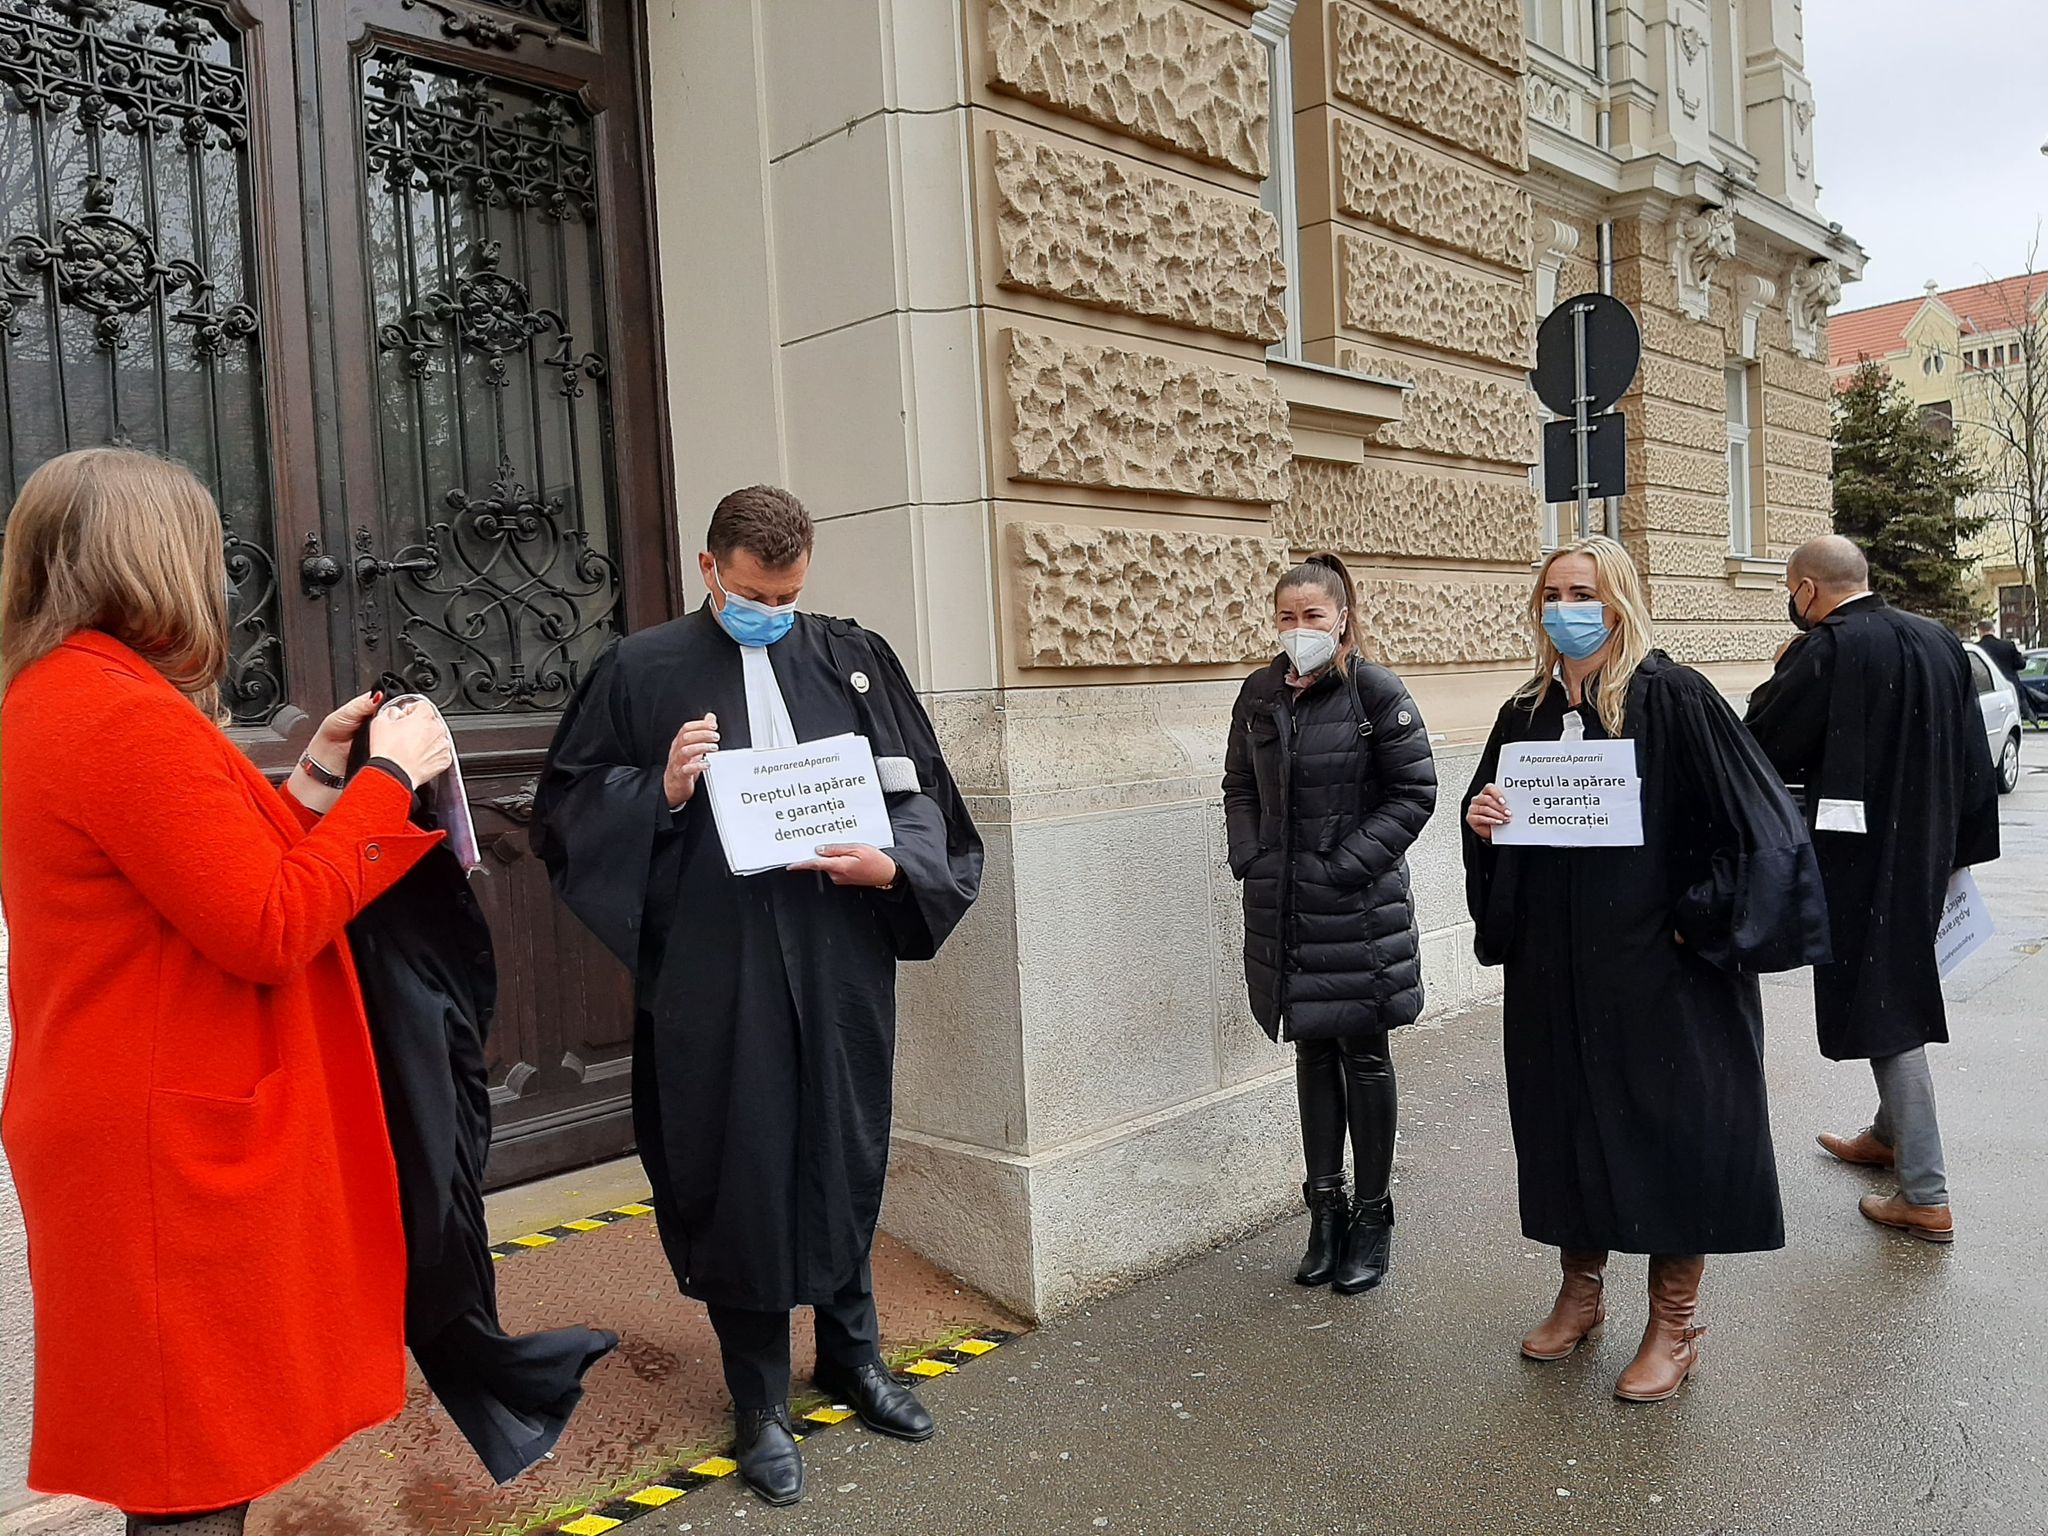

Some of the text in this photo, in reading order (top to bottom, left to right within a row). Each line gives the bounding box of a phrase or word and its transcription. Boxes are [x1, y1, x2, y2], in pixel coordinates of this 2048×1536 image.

[753, 753, 840, 775] #AparareaApararii
[1519, 753, 1603, 765] #AparareaApararii
[741, 774, 866, 804] Dreptul la apărare
[1504, 775, 1626, 791] Dreptul la apărare
[775, 798, 845, 822] e garanția
[1532, 794, 1600, 809] e garanția
[774, 815, 858, 841] democrației
[1528, 813, 1609, 829] democrației
